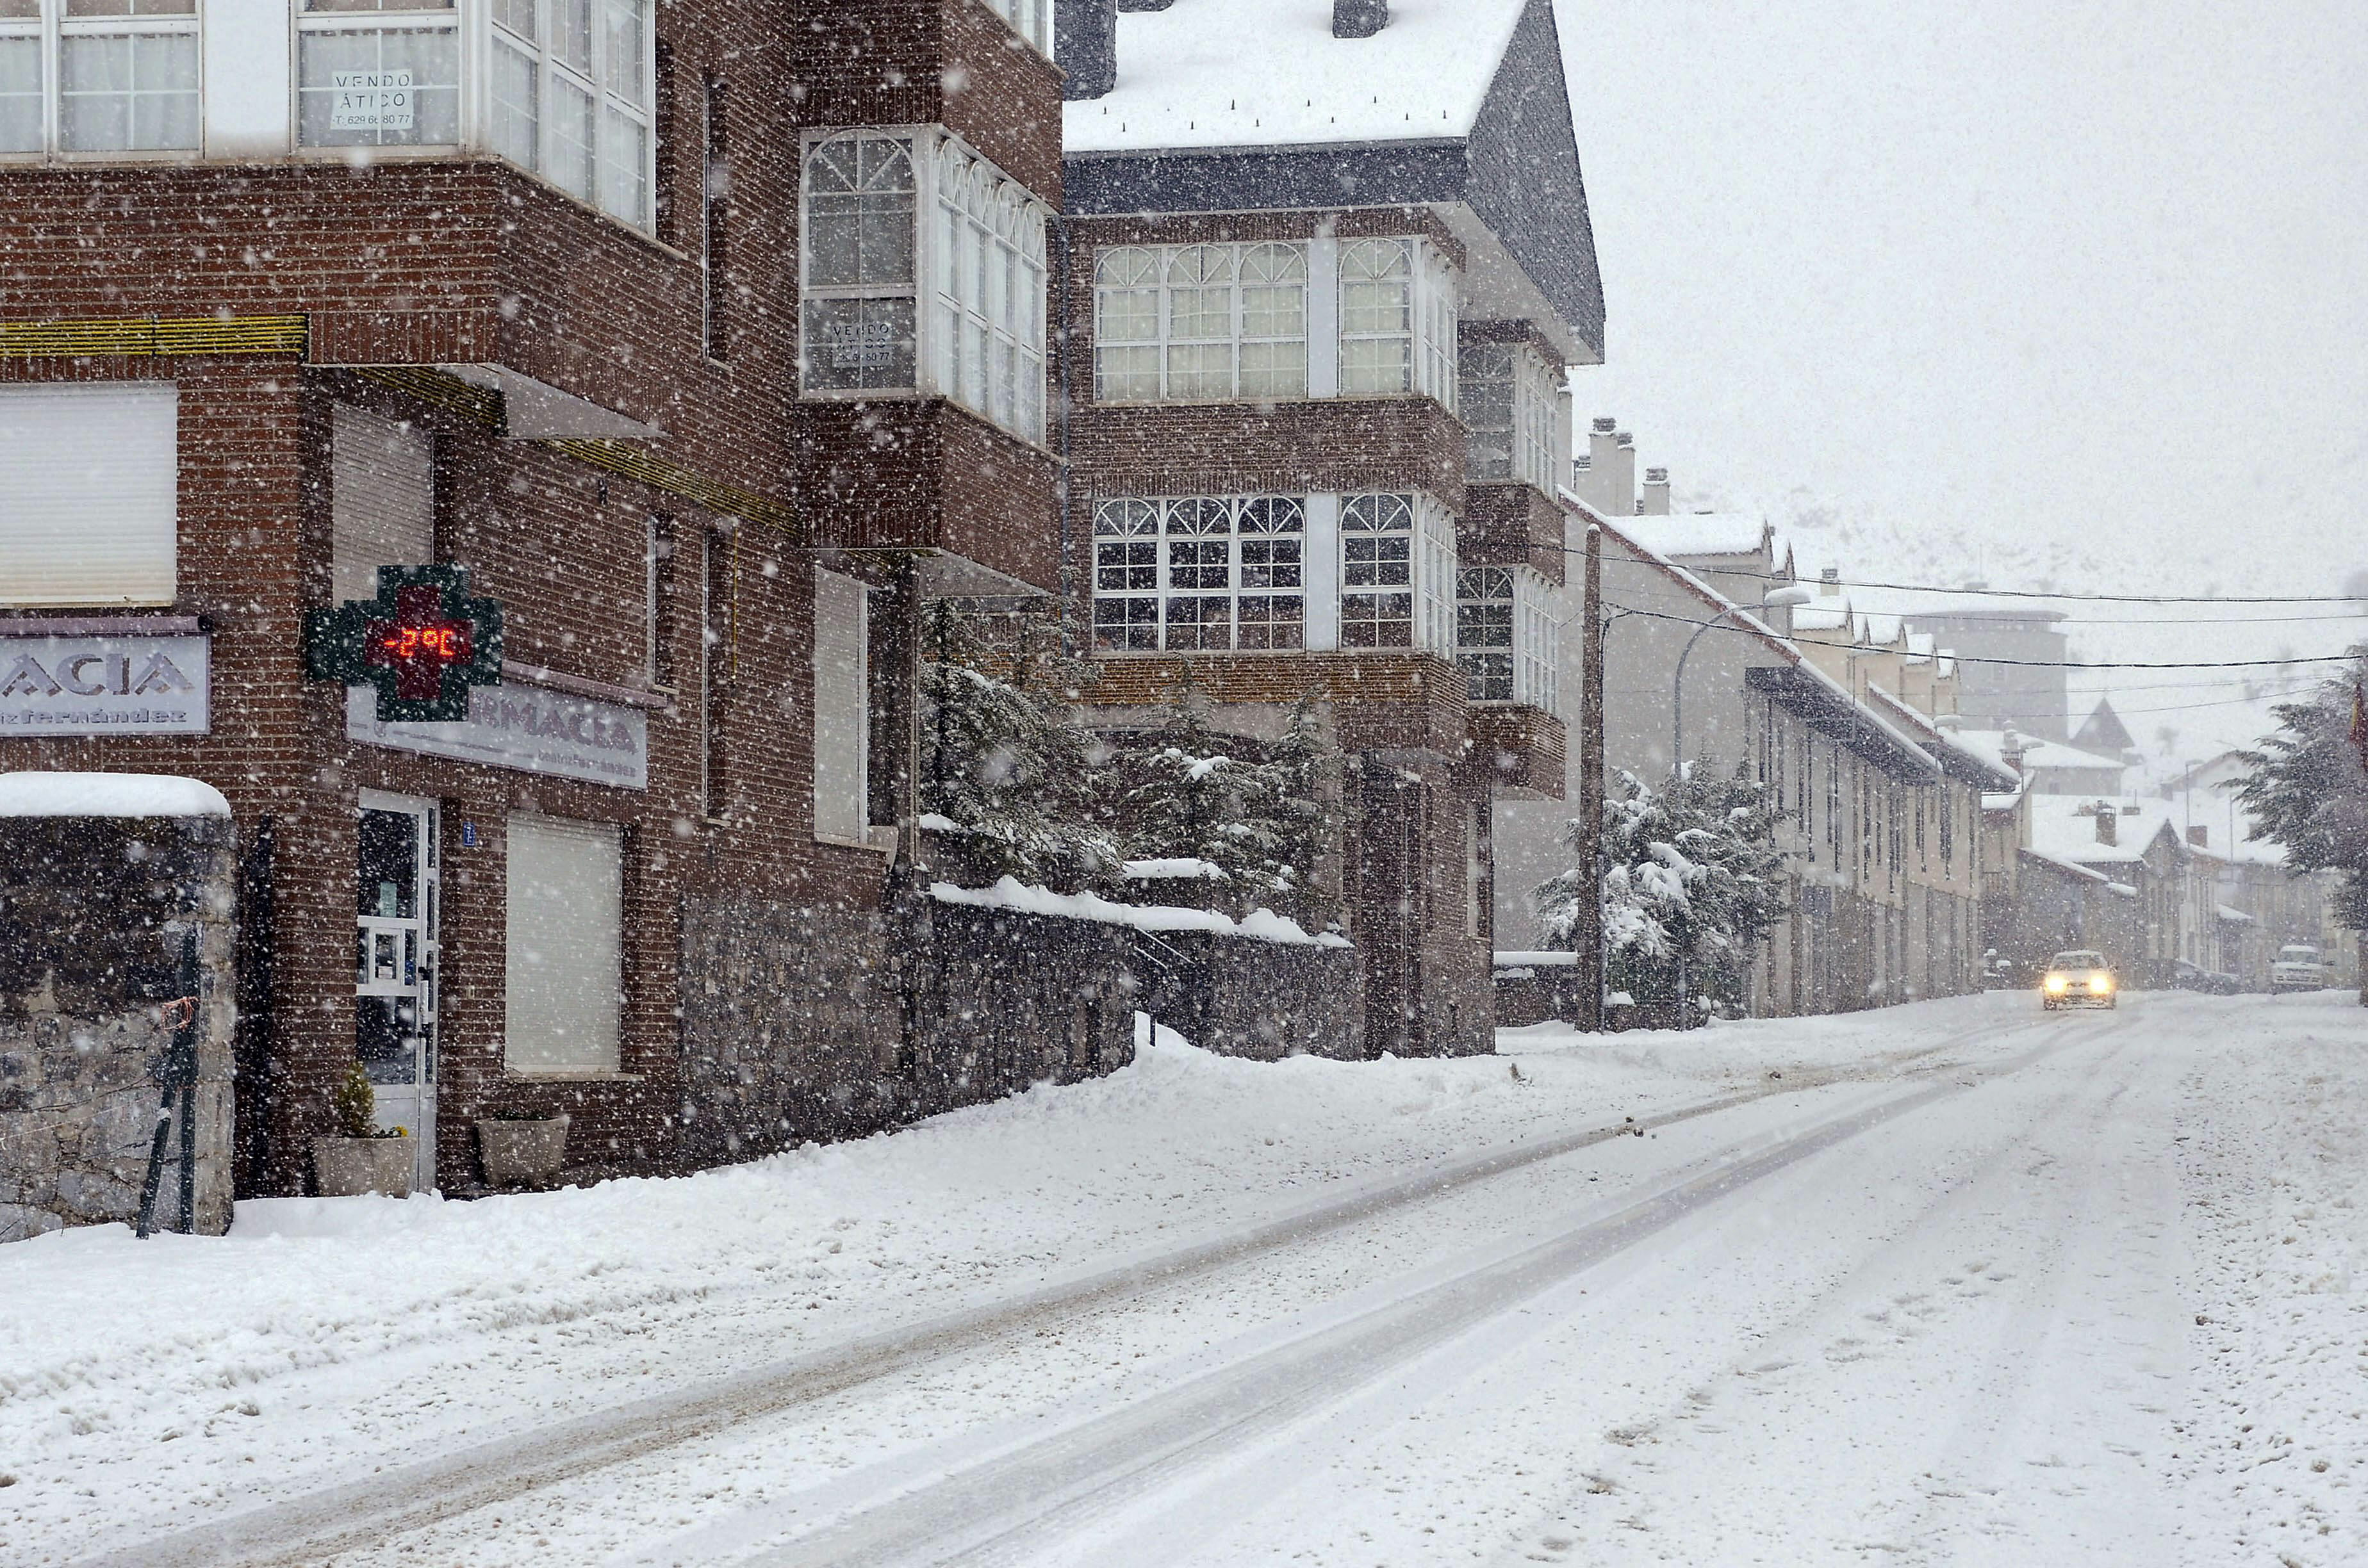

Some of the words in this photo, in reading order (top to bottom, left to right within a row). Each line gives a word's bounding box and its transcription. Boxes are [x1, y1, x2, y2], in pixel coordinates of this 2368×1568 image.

[336, 74, 409, 87] VENDO
[348, 116, 365, 124] 629
[383, 115, 395, 124] 80
[399, 115, 409, 124] 77
[833, 323, 889, 336] VENDO
[880, 352, 889, 361] 77
